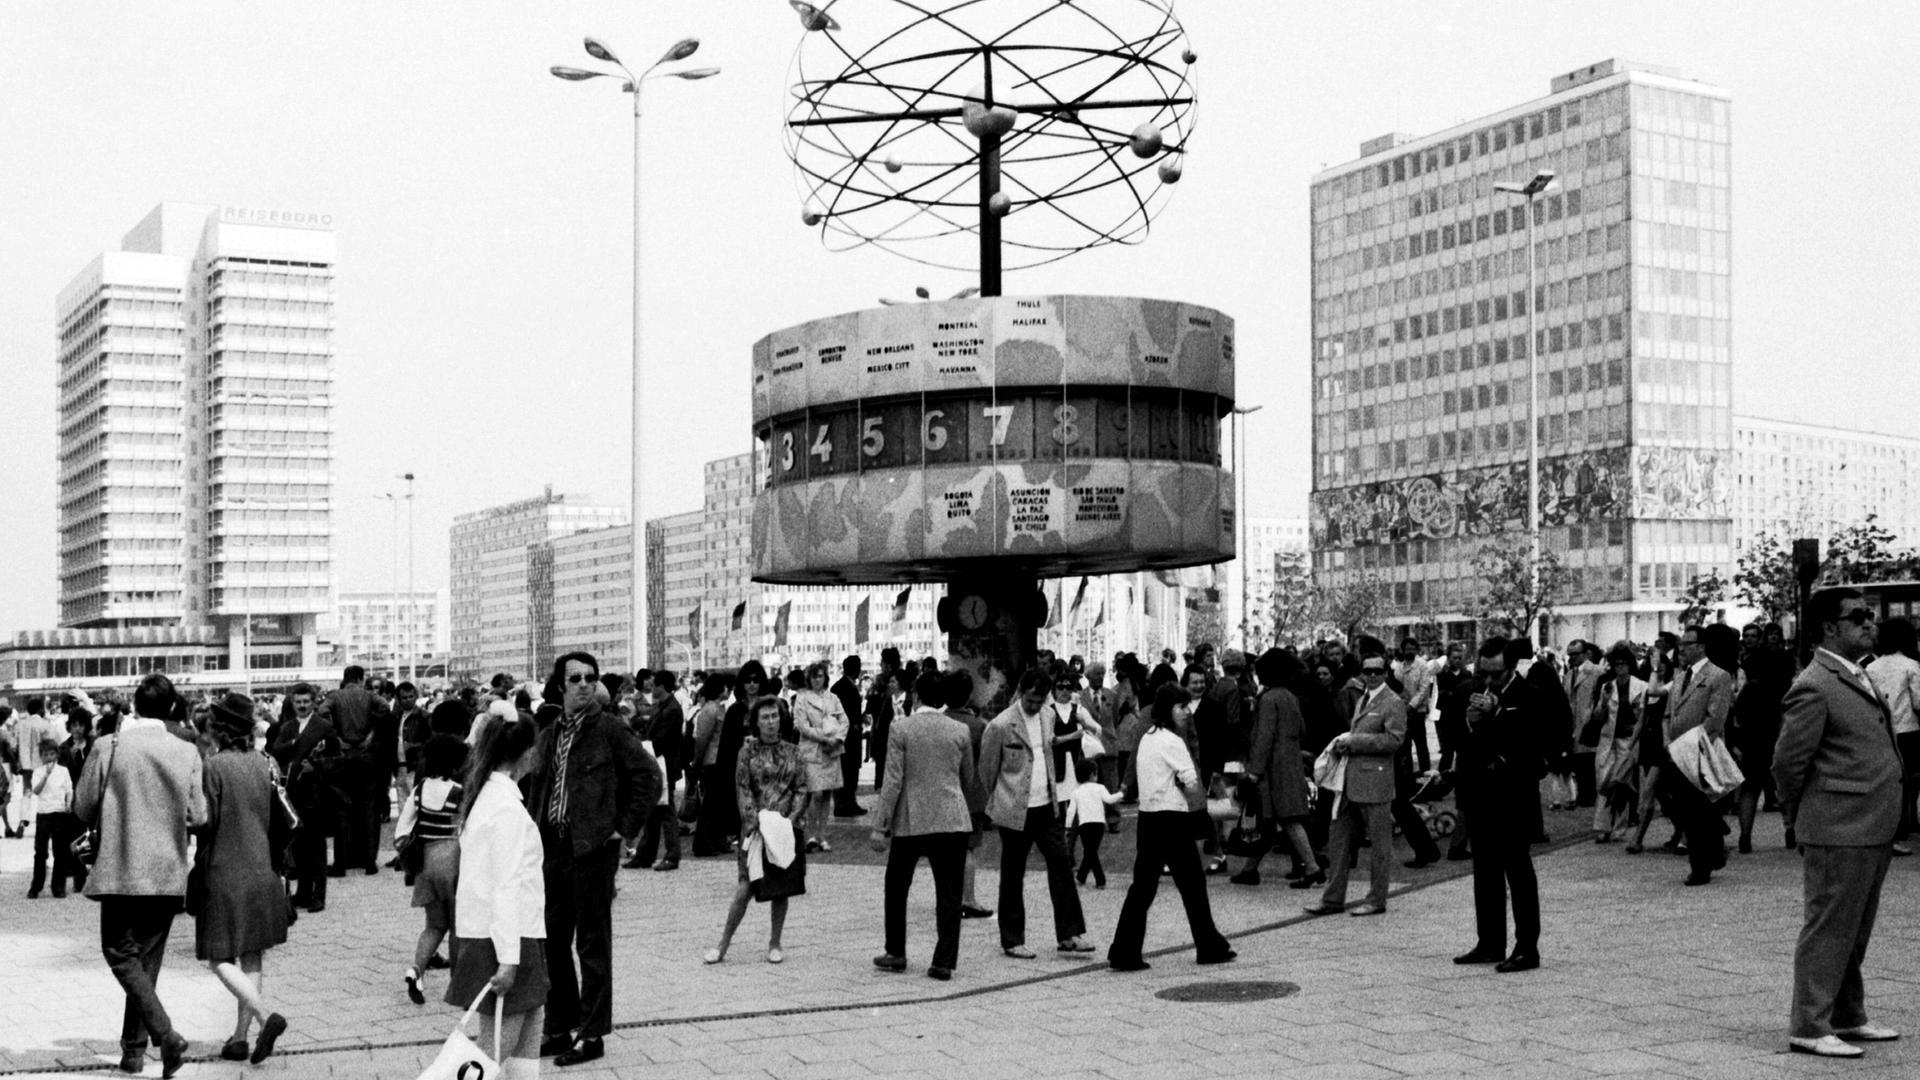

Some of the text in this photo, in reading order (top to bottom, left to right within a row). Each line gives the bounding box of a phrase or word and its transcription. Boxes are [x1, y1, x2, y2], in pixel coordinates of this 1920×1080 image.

[938, 321, 978, 331] MONTREAL
[1012, 318, 1047, 327] HALIFAX
[932, 338, 984, 349] WASHINGTON
[811, 424, 833, 463] 4
[863, 416, 885, 457] 5
[924, 409, 948, 451] 6
[983, 405, 1014, 445] 7
[1052, 404, 1080, 445] 8
[782, 431, 794, 471] 3
[947, 509, 971, 519] QUITO
[949, 501, 969, 509] LIMA
